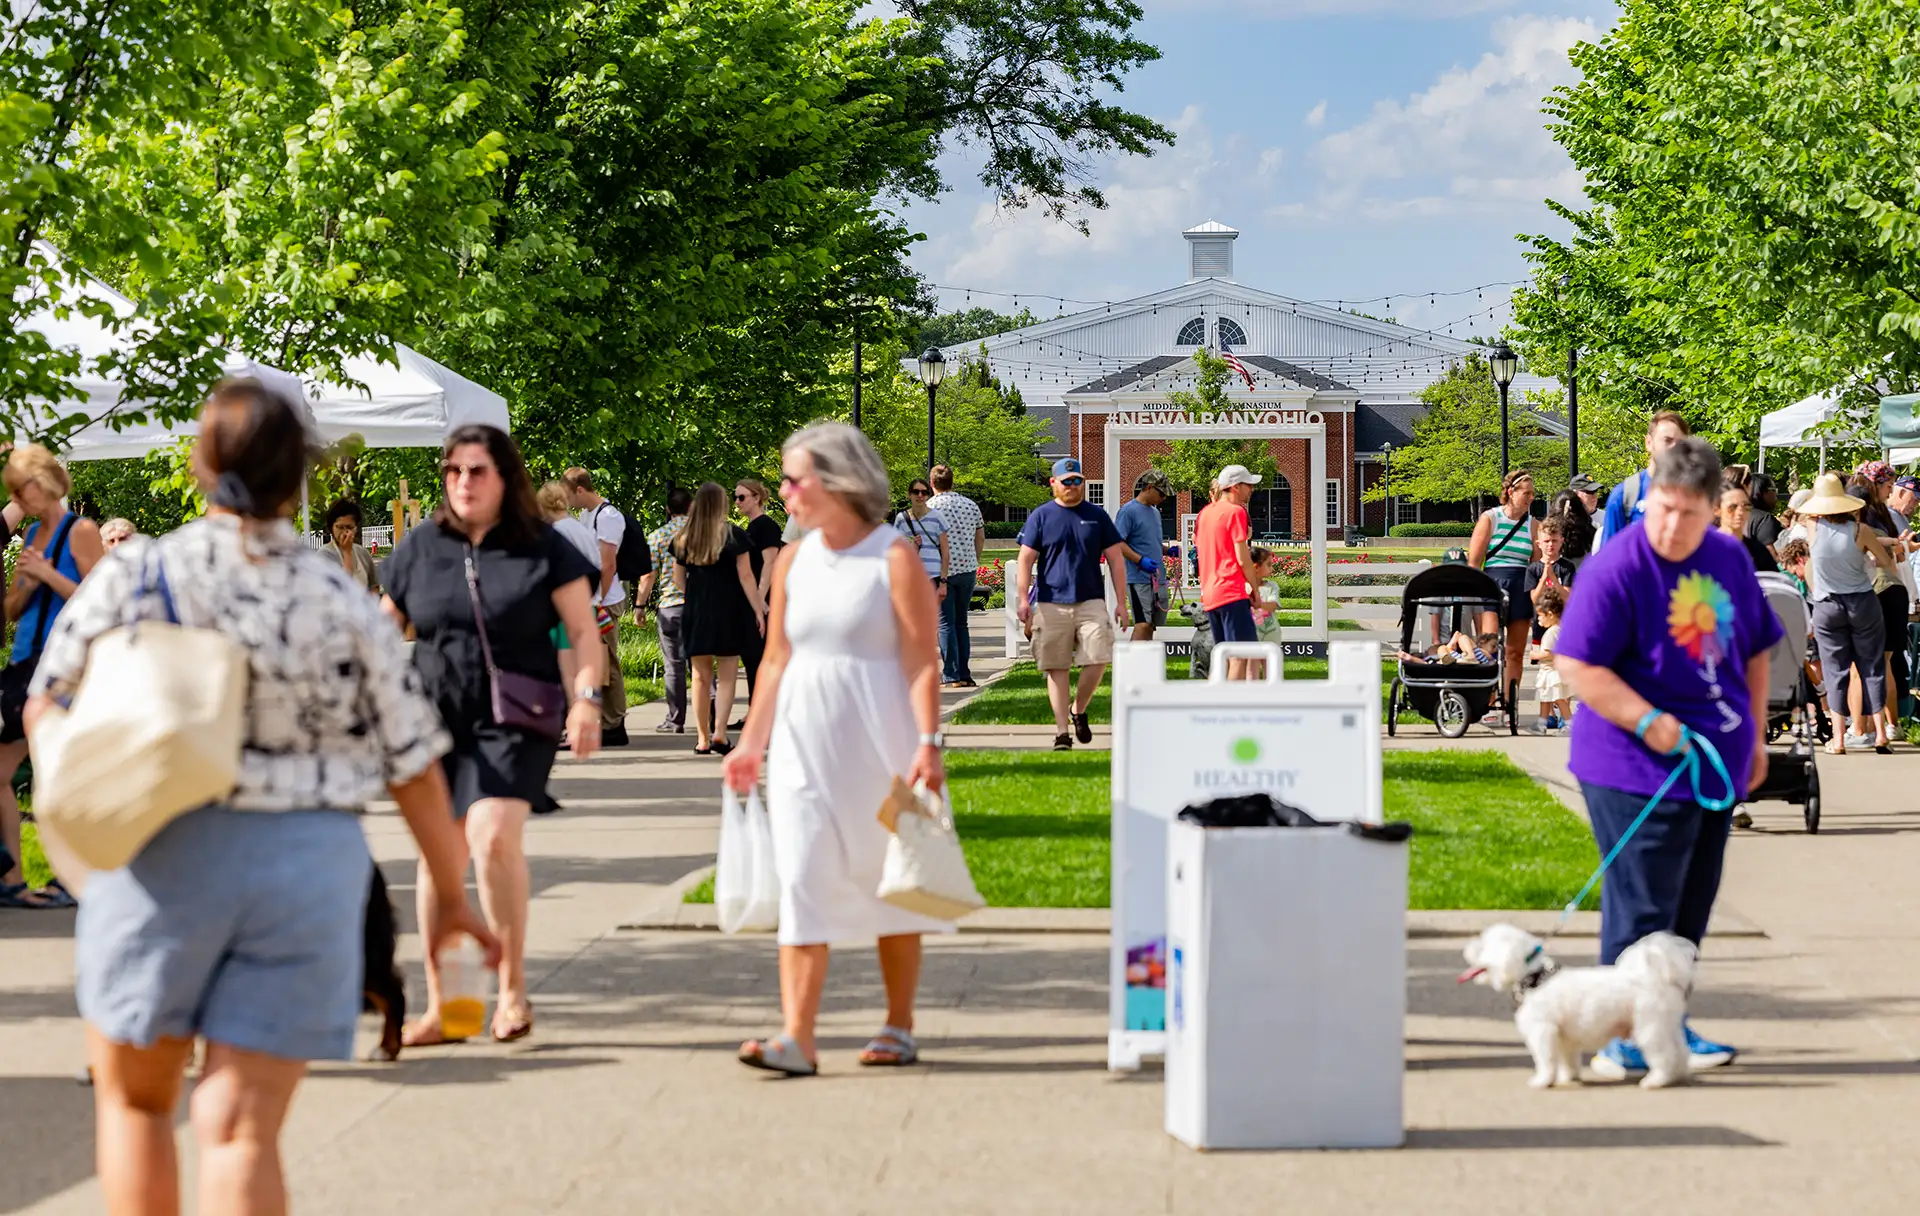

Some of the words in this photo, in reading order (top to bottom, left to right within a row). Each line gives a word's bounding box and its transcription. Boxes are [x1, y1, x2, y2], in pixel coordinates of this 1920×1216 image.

[1227, 402, 1282, 410] YMNASIUM
[1297, 645, 1314, 655] US
[1193, 769, 1300, 788] HEALTHY
